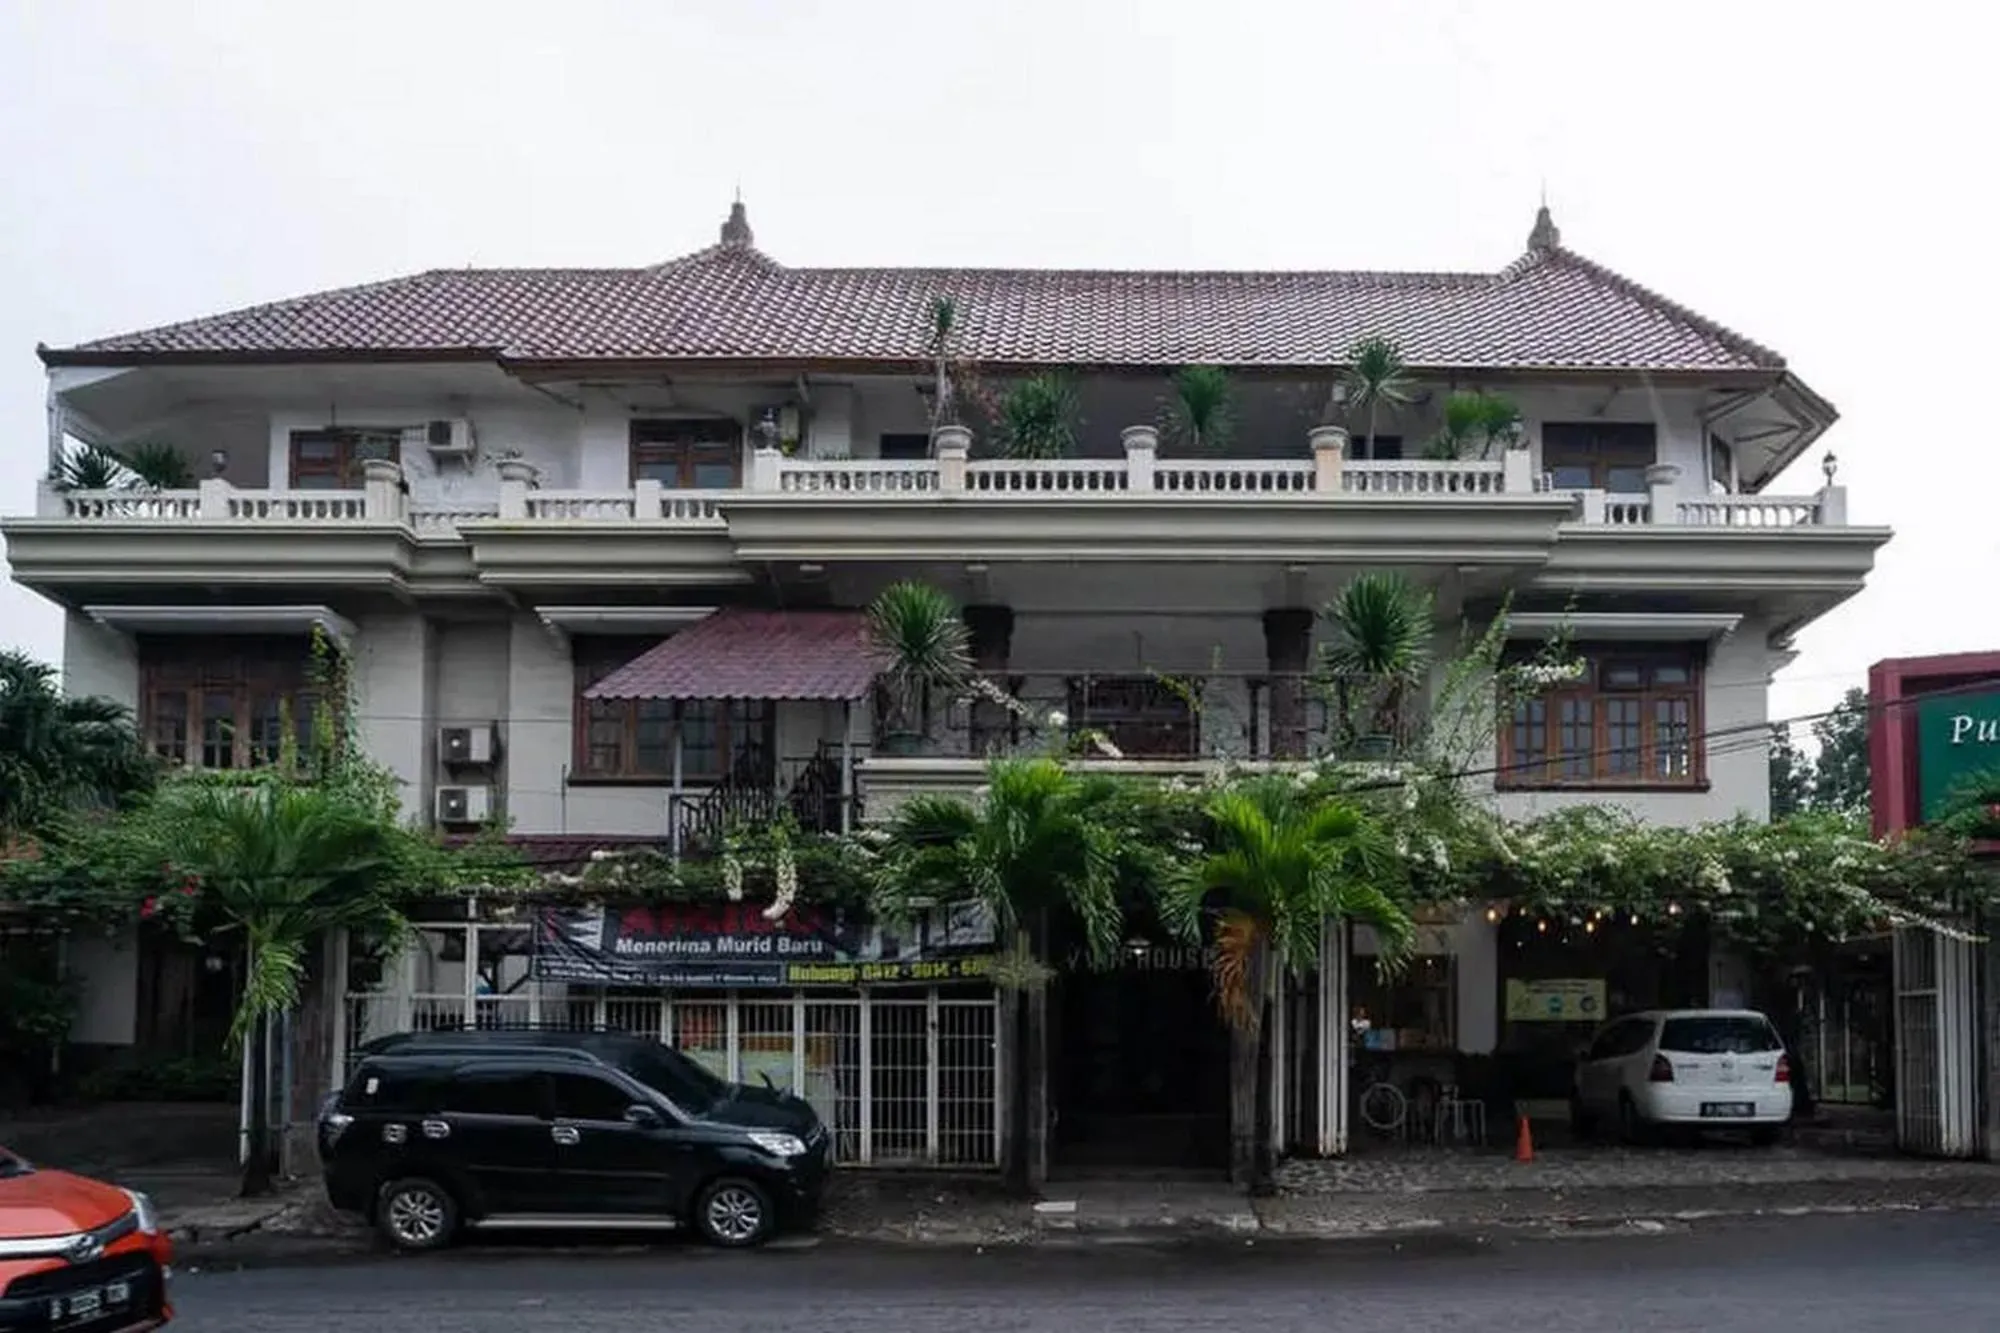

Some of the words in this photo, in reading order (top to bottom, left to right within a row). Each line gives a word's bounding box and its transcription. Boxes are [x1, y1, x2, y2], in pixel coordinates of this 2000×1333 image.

[1951, 713, 2000, 743] Pu
[615, 936, 711, 954] Menerima
[716, 935, 771, 953] Murid
[777, 937, 823, 953] Baru
